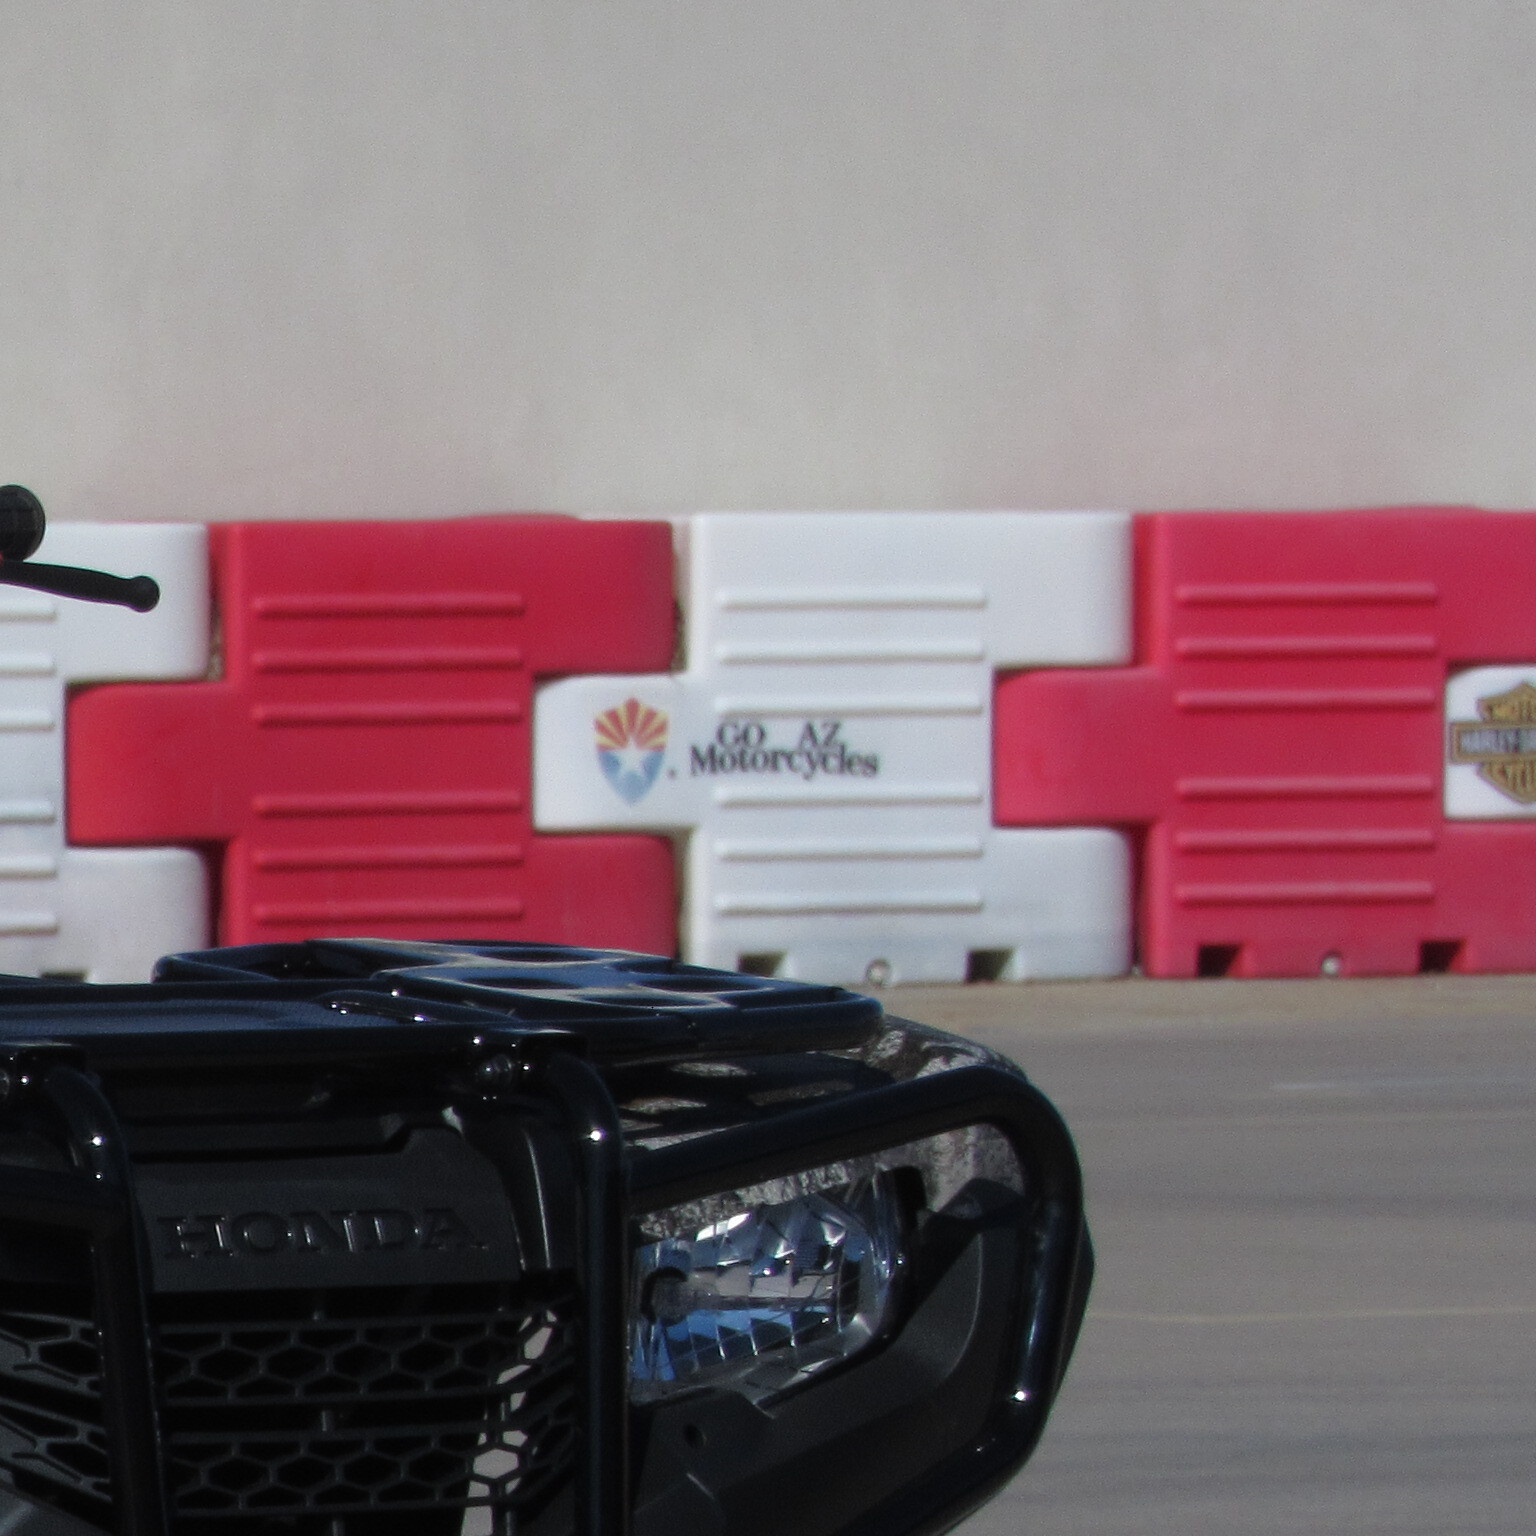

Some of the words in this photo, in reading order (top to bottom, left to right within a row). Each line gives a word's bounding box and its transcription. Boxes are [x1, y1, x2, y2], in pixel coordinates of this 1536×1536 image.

[715, 720, 766, 749] GO
[797, 719, 842, 749] AZ
[689, 744, 879, 781] Motorcycles
[157, 1207, 490, 1259] HONDA
